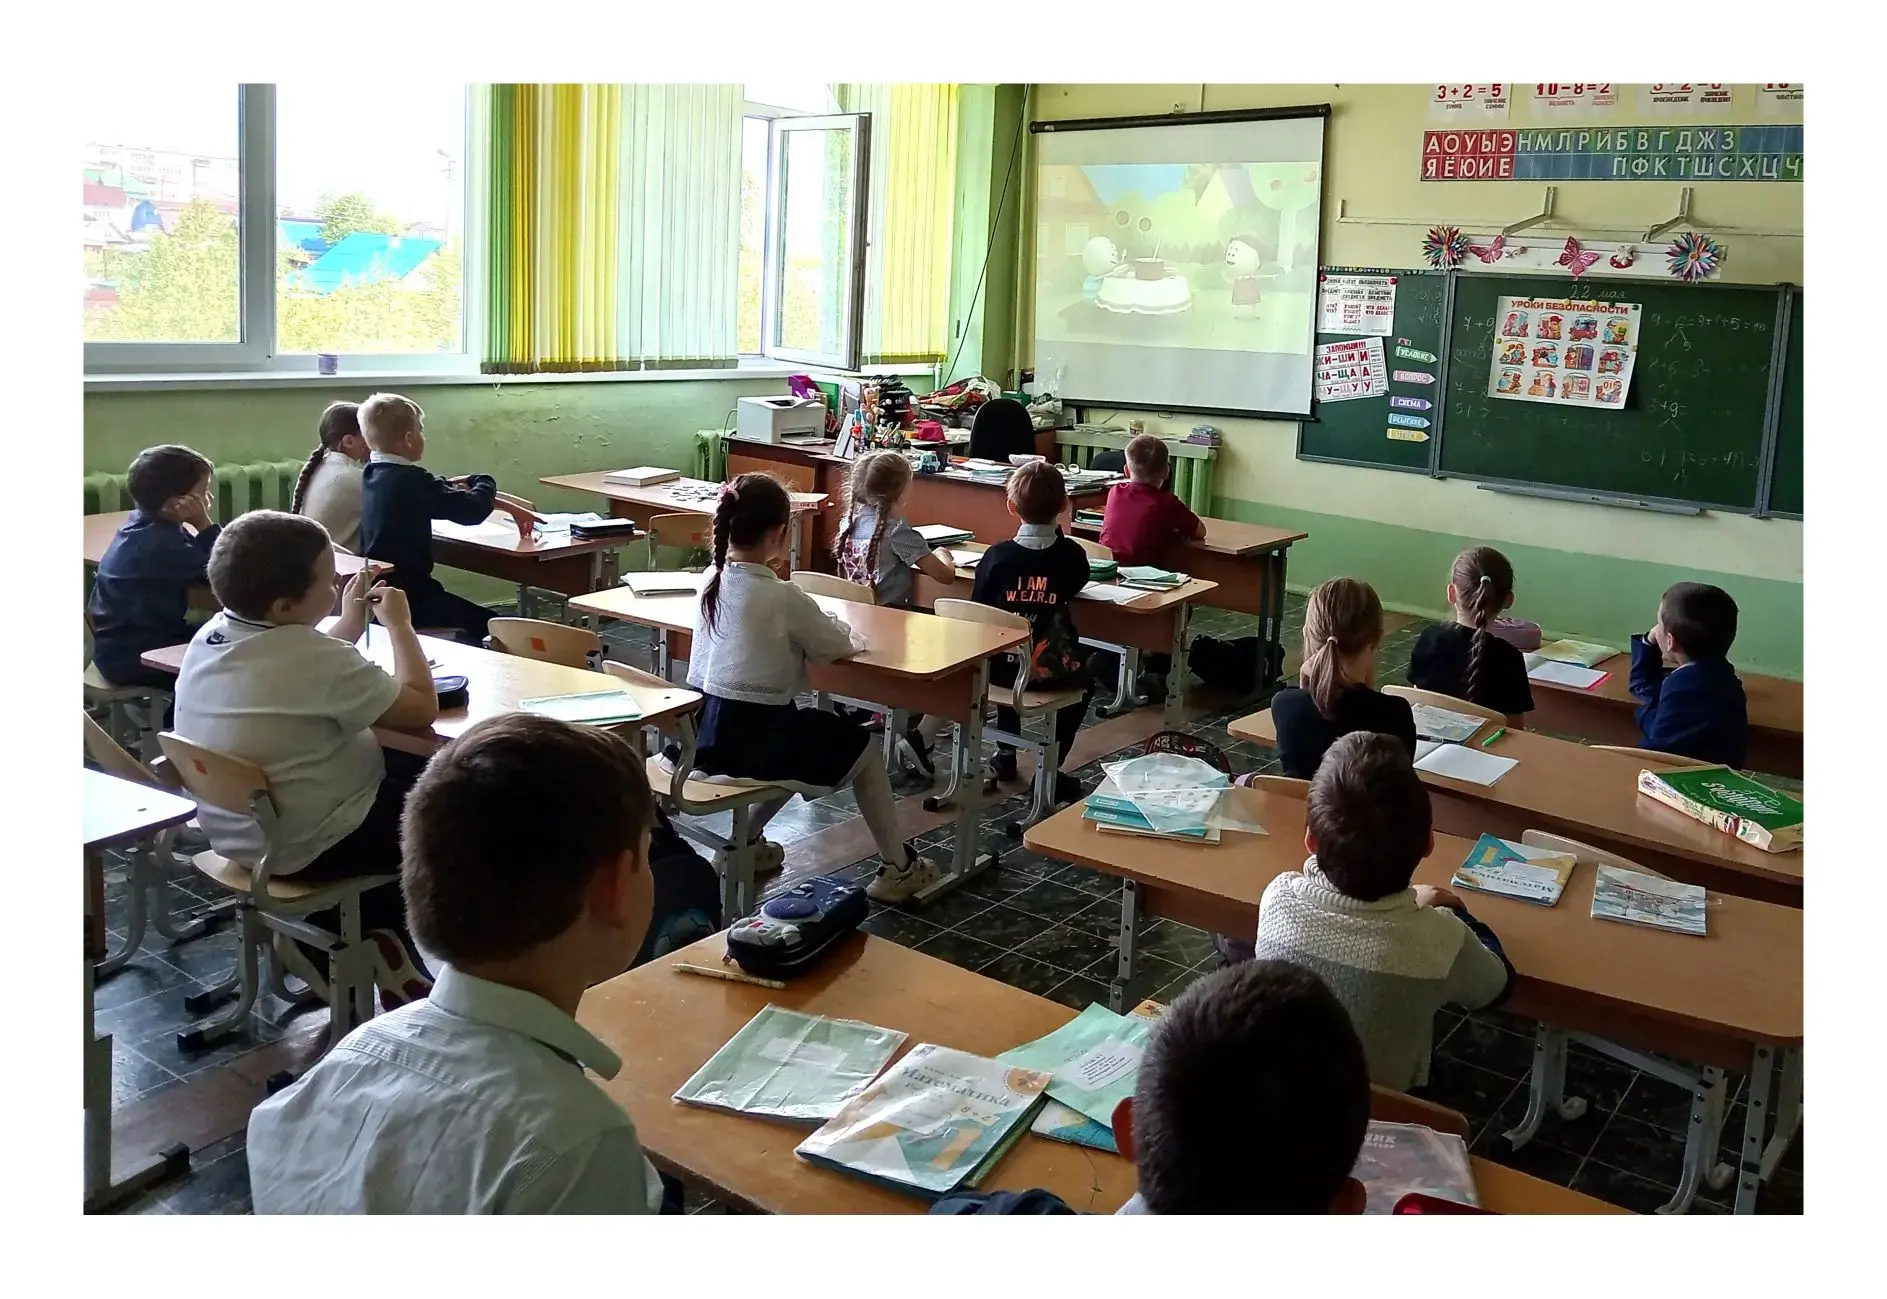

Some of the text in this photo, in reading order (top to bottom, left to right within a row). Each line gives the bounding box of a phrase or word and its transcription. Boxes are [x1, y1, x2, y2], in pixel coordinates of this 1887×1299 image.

[1437, 85, 1447, 99] 3
[1463, 84, 1473, 98] 2
[1491, 83, 1502, 97] 5
[1512, 300, 1629, 314] УРОКИ БЕЗОПАСНОСТИ
[1398, 398, 1421, 408] СХЕМА
[1026, 576, 1048, 592] AM
